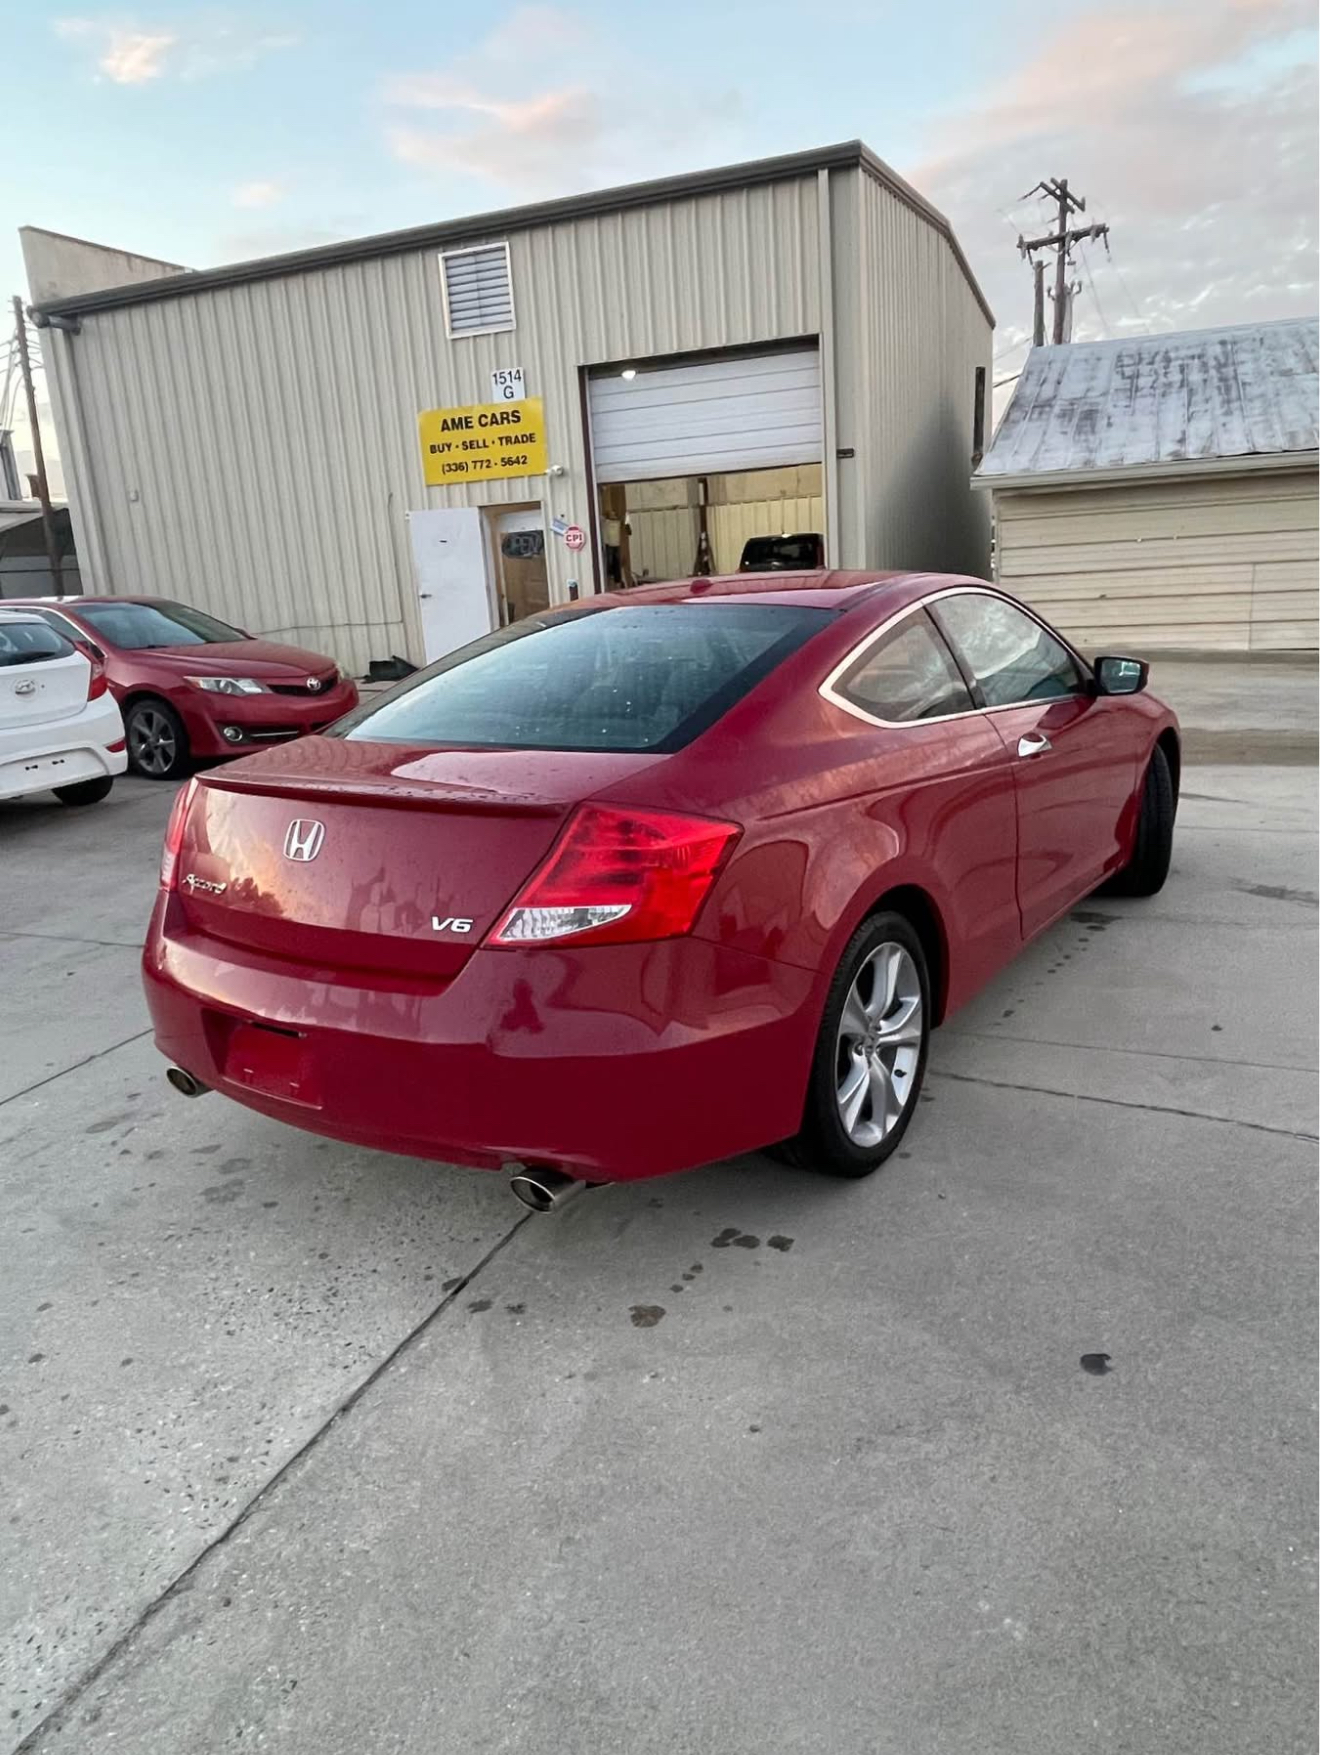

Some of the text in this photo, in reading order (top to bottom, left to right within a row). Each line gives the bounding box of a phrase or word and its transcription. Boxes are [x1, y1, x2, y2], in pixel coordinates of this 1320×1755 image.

[493, 369, 522, 385] 1514
[503, 385, 514, 399] G
[441, 410, 521, 432] AME CARS
[430, 433, 536, 454] BUY SELL TRADE
[442, 455, 528, 475] (336) 772 5642
[566, 534, 582, 542] CPI
[431, 916, 473, 933] V6
